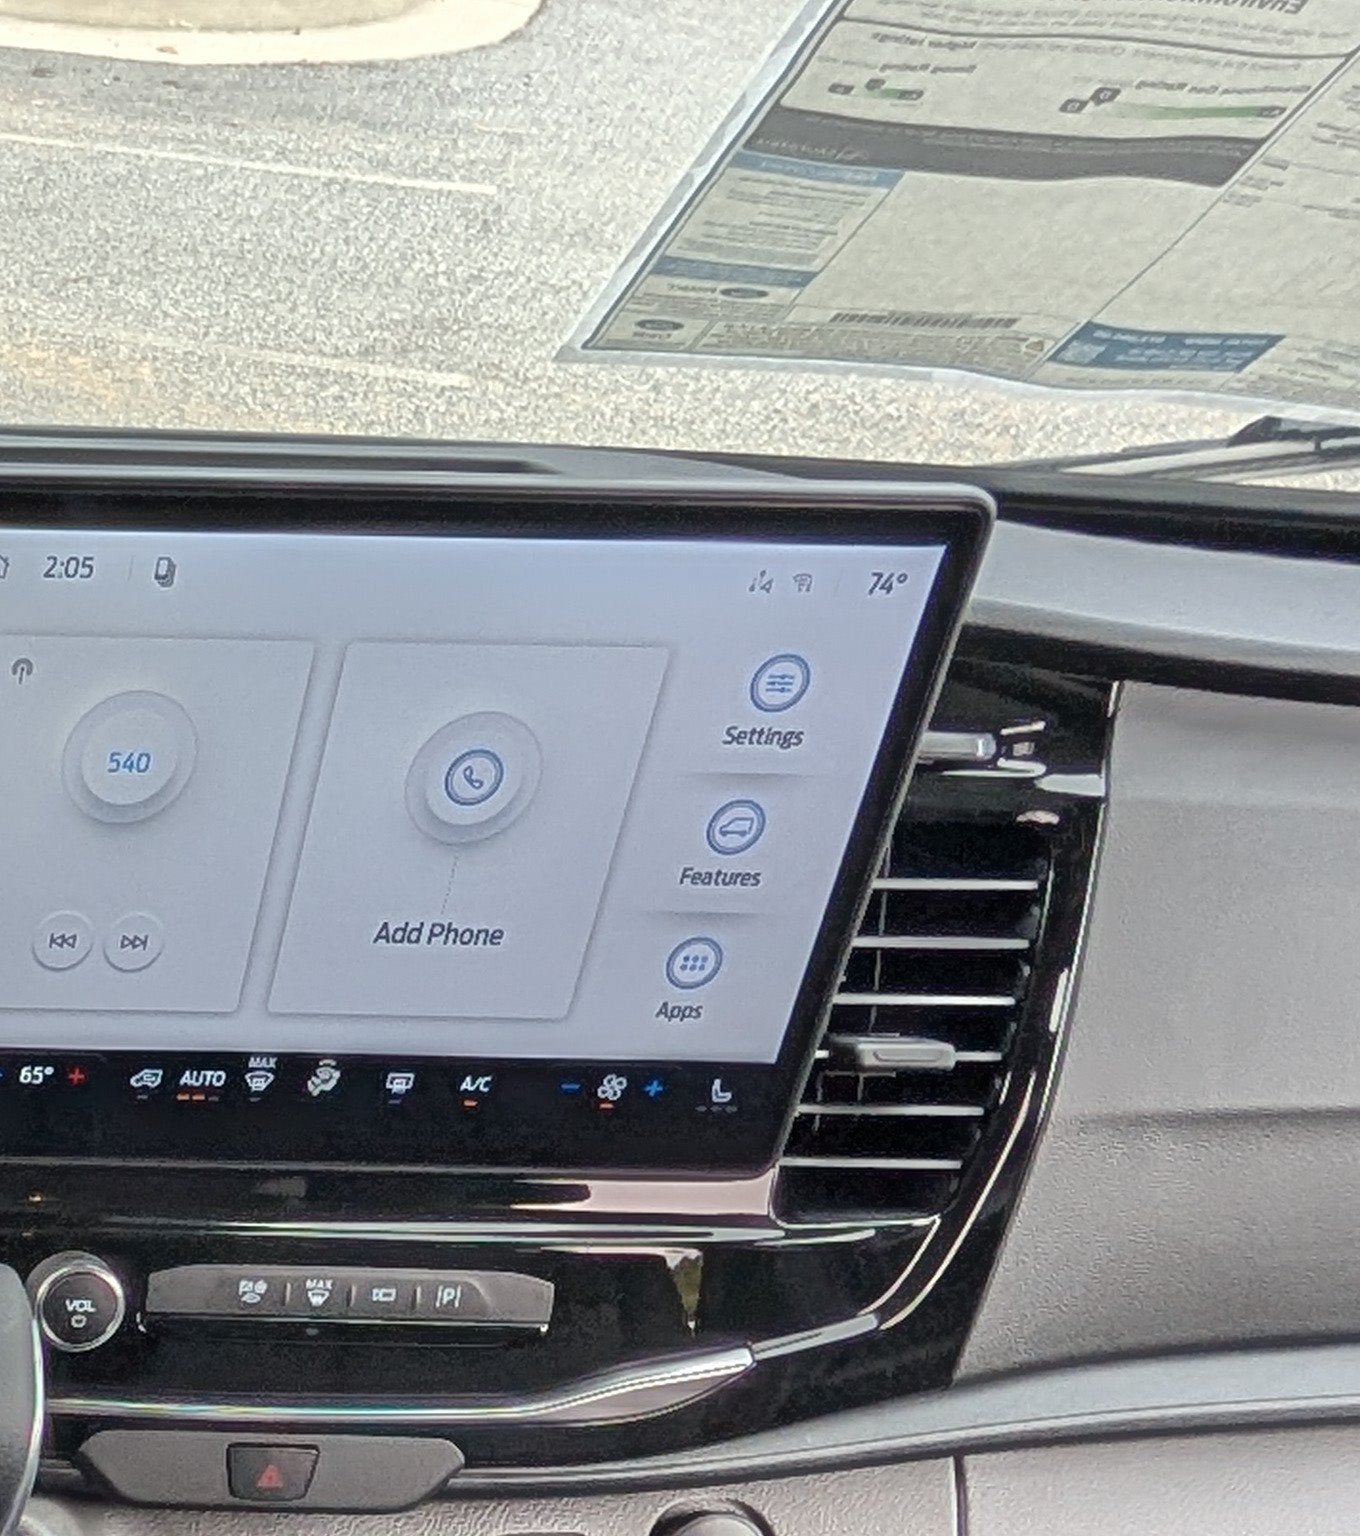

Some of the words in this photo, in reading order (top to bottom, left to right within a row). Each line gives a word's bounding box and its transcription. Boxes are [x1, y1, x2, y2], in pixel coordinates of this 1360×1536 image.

[43, 556, 94, 579] 2:05
[722, 726, 804, 750] Settings
[107, 751, 152, 774] 540
[679, 867, 762, 887] Features
[373, 921, 424, 944] Add
[427, 922, 504, 946] Phone
[655, 1002, 703, 1022] Apps
[248, 1056, 278, 1069] MAX
[180, 1070, 227, 1087] AUTO
[460, 1075, 494, 1093] A/C
[305, 1279, 333, 1290] MAX
[65, 1299, 96, 1314] VOL
